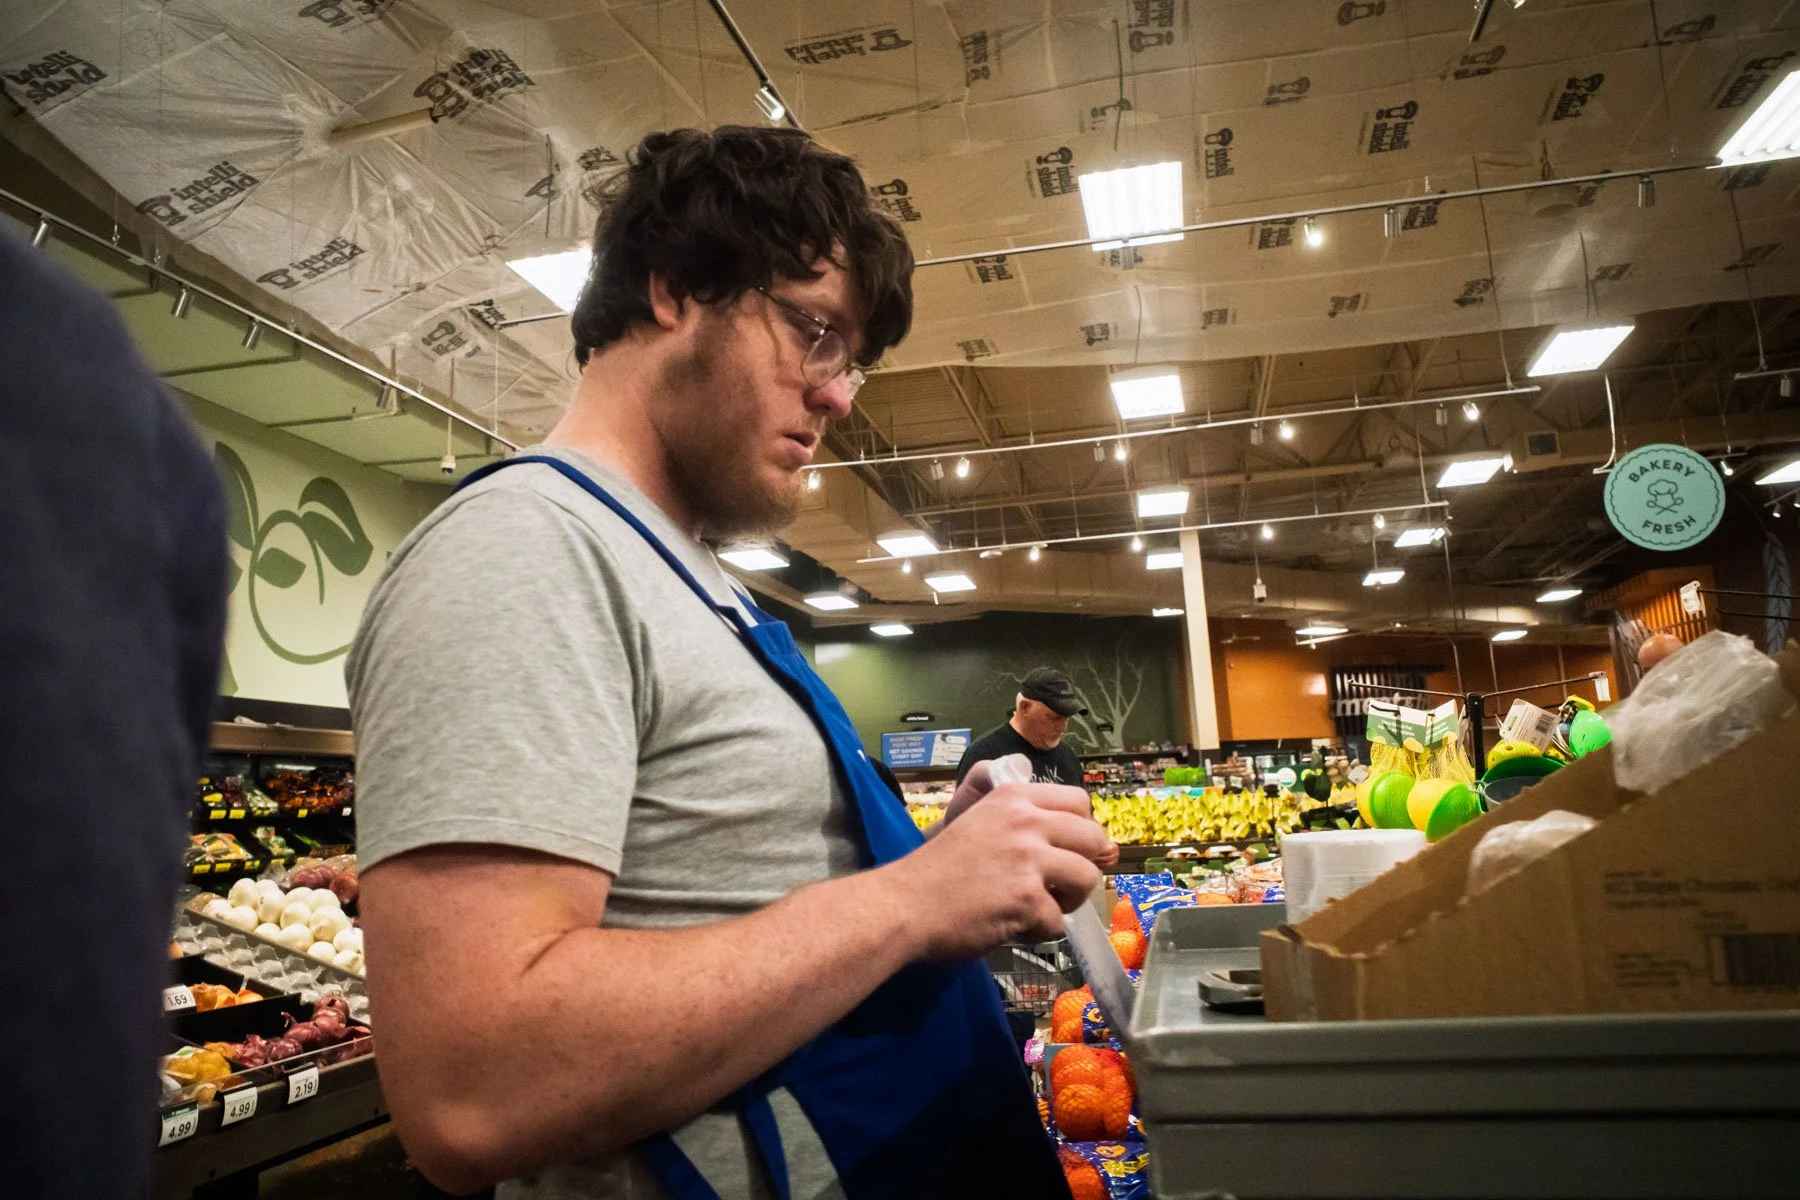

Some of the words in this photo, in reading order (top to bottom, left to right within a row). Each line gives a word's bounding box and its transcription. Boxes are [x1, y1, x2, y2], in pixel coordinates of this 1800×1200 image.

[169, 160, 242, 202] intelli
[187, 172, 260, 214] shield
[1628, 459, 1696, 483] BAKERY
[1642, 515, 1696, 534] FRESH
[167, 994, 188, 1007] 1.69
[295, 1081, 314, 1099] 2.19
[230, 1102, 250, 1118] 4.99
[168, 1121, 192, 1139] 4.99
